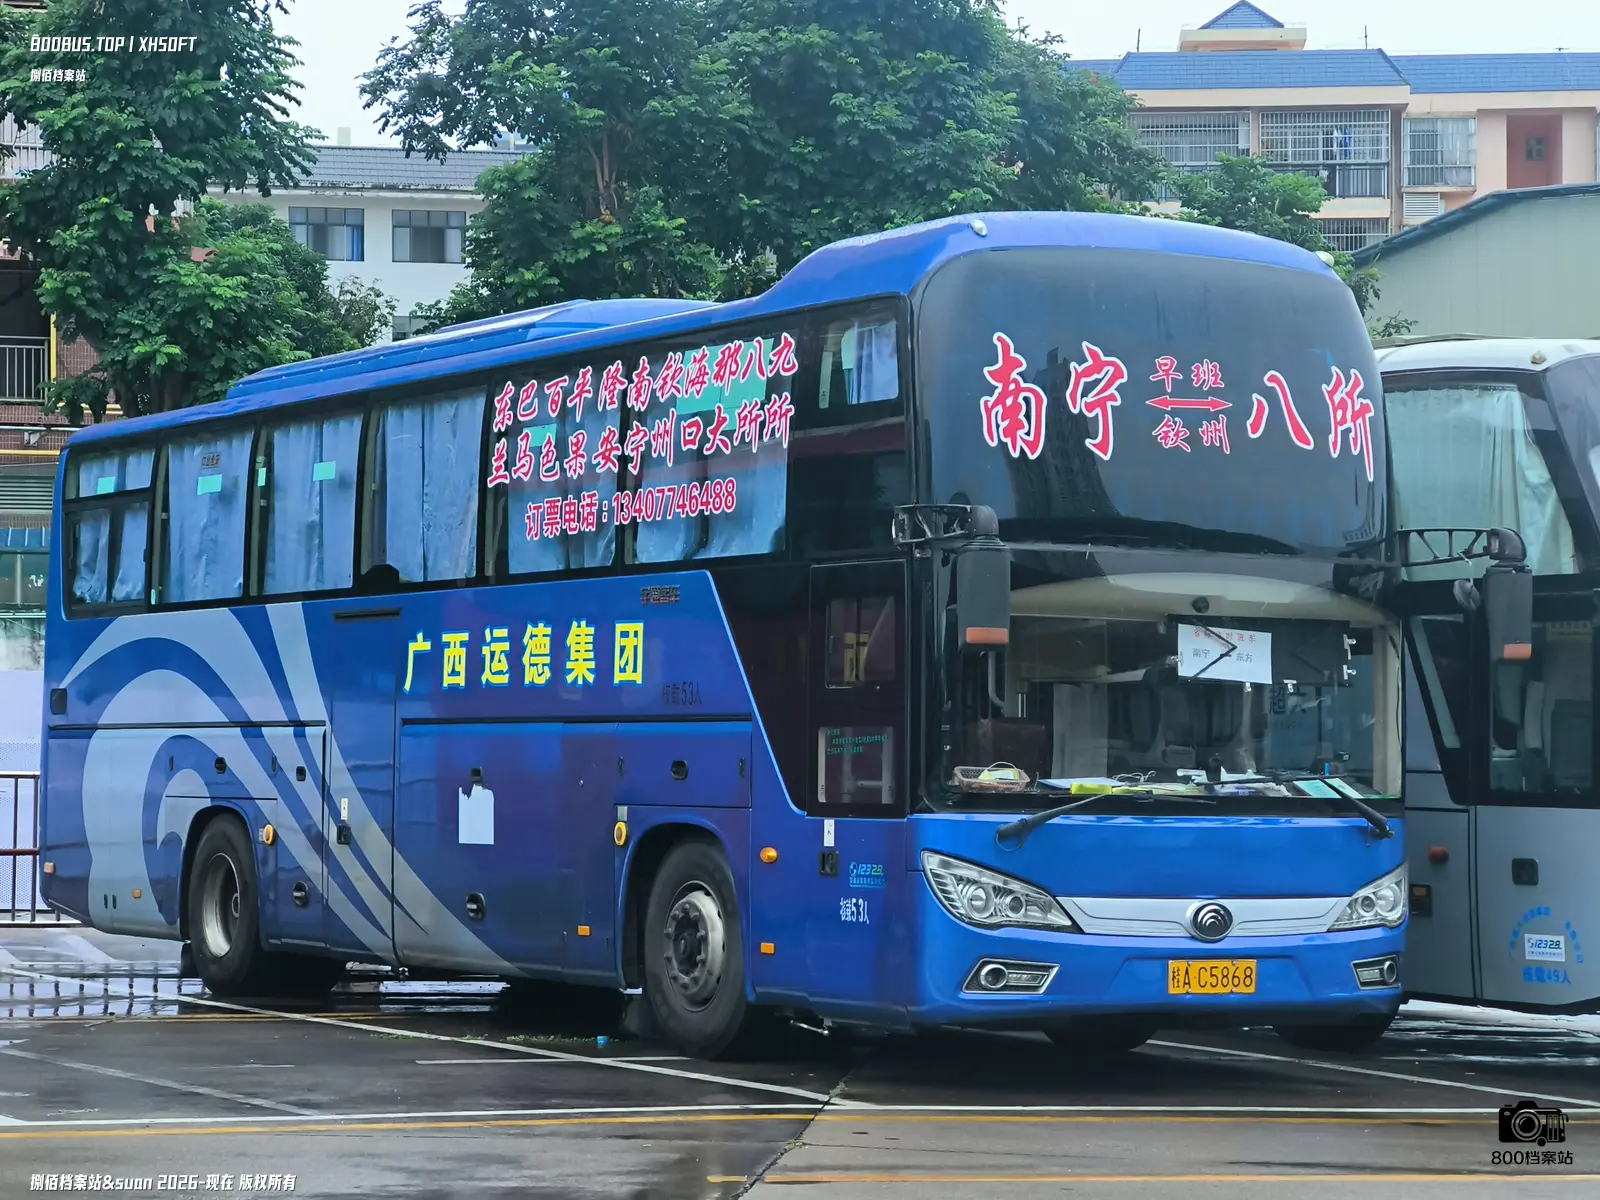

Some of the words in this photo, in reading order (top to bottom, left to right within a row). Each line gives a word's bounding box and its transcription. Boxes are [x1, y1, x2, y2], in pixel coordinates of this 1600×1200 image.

[980, 332, 1128, 461] 南宁
[1150, 355, 1225, 392] 早班
[1152, 414, 1231, 454] 钦州
[1246, 366, 1375, 481] 八所
[403, 619, 645, 695] 广西运德集团
